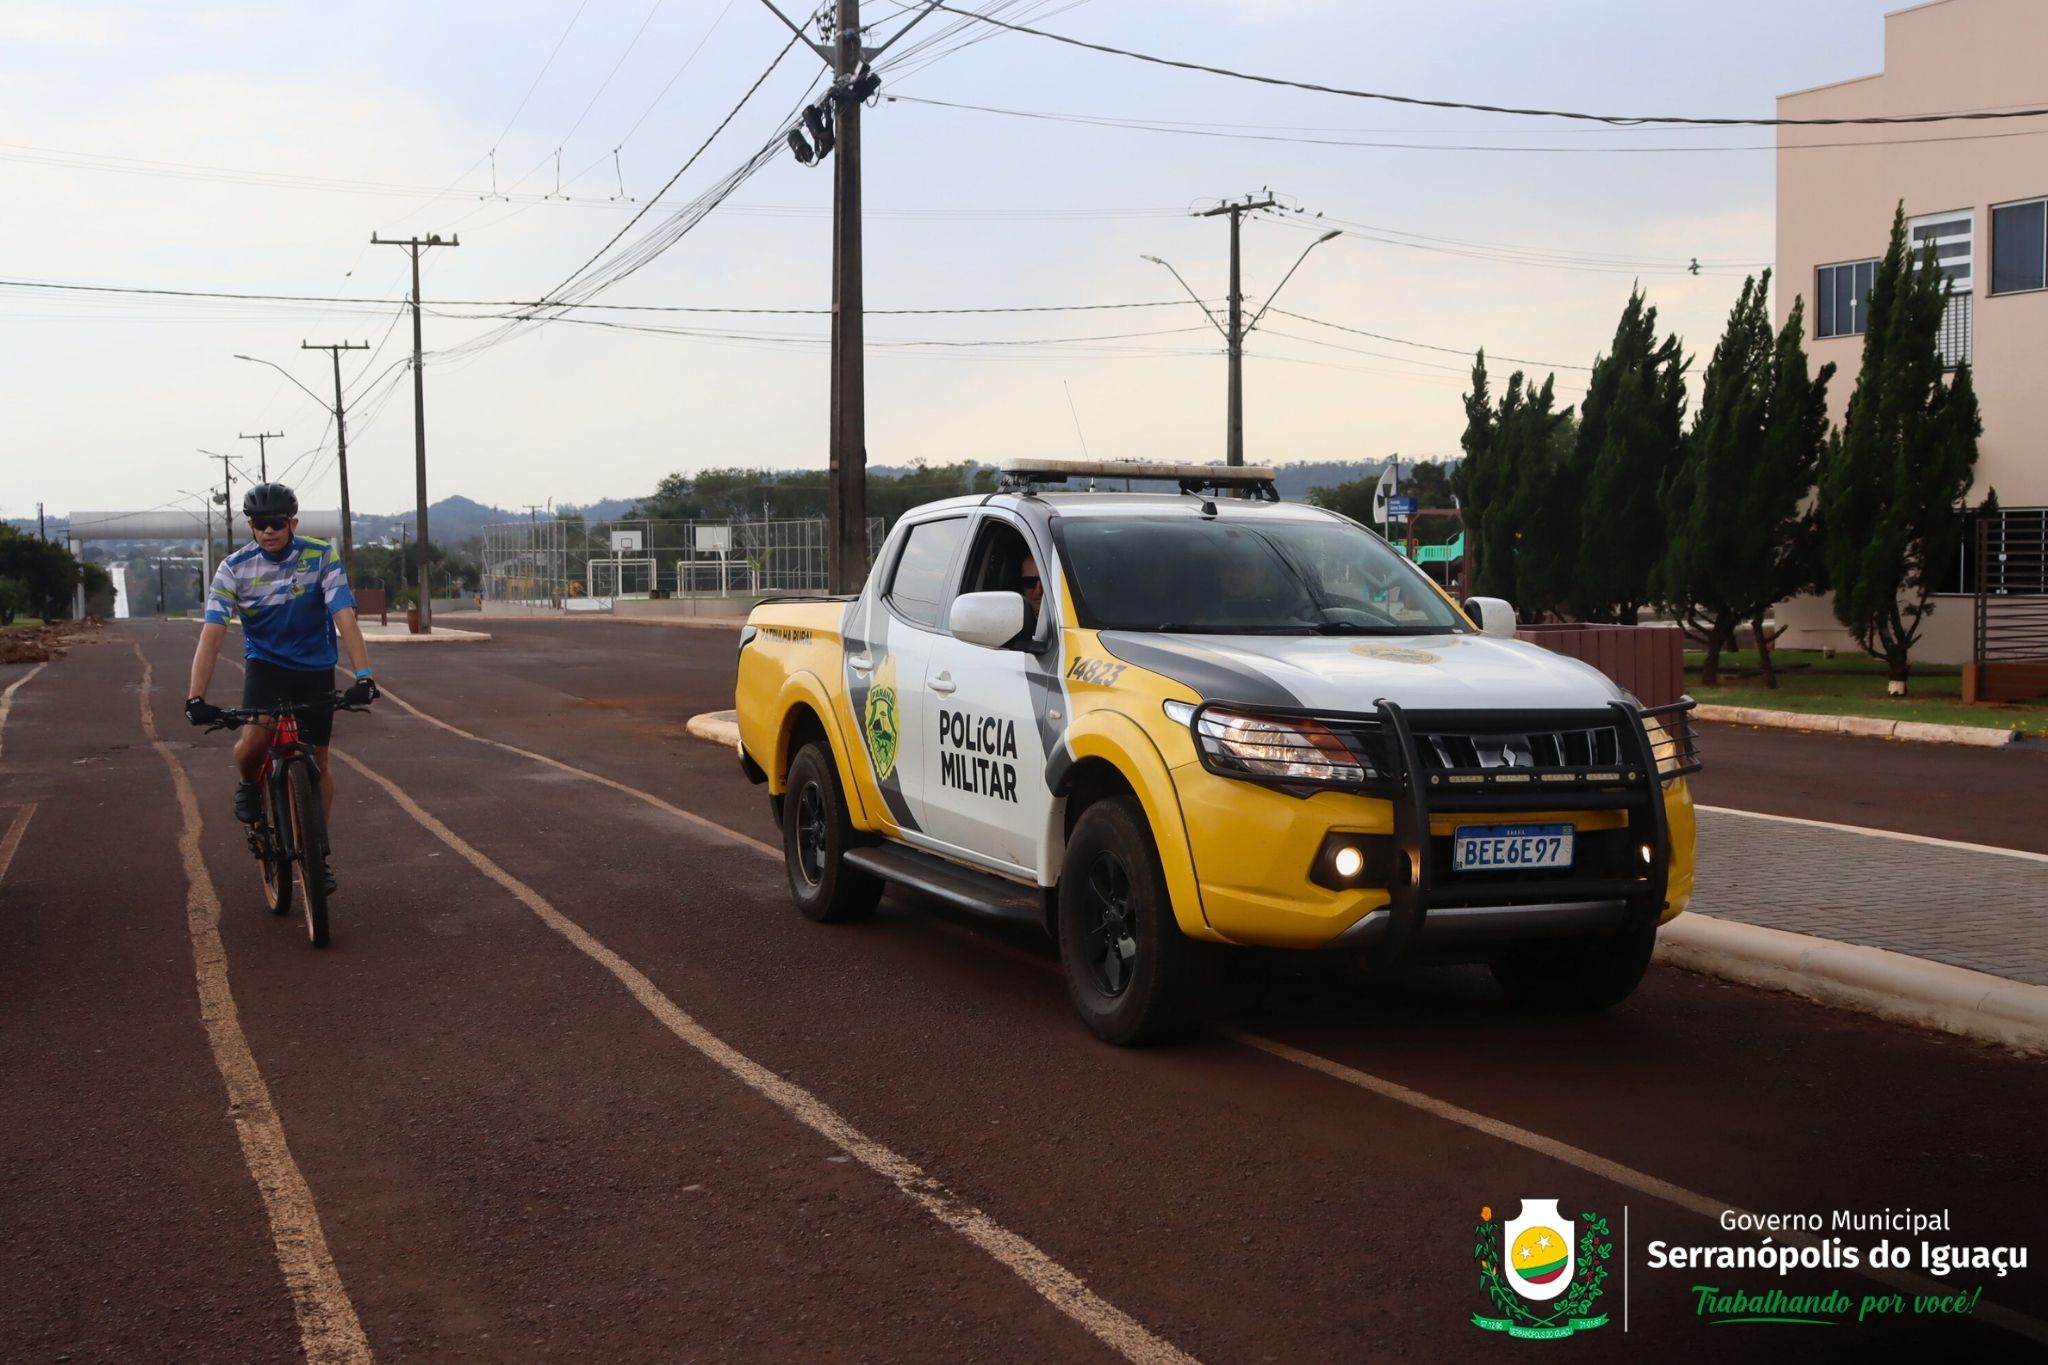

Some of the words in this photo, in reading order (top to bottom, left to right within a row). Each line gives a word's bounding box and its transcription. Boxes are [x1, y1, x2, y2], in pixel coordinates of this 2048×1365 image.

[1066, 656, 1127, 687] 14823
[939, 709, 1018, 760] POLÍCIA
[941, 750, 1019, 804] MILITAR
[1465, 838, 1562, 866] BEE6E97
